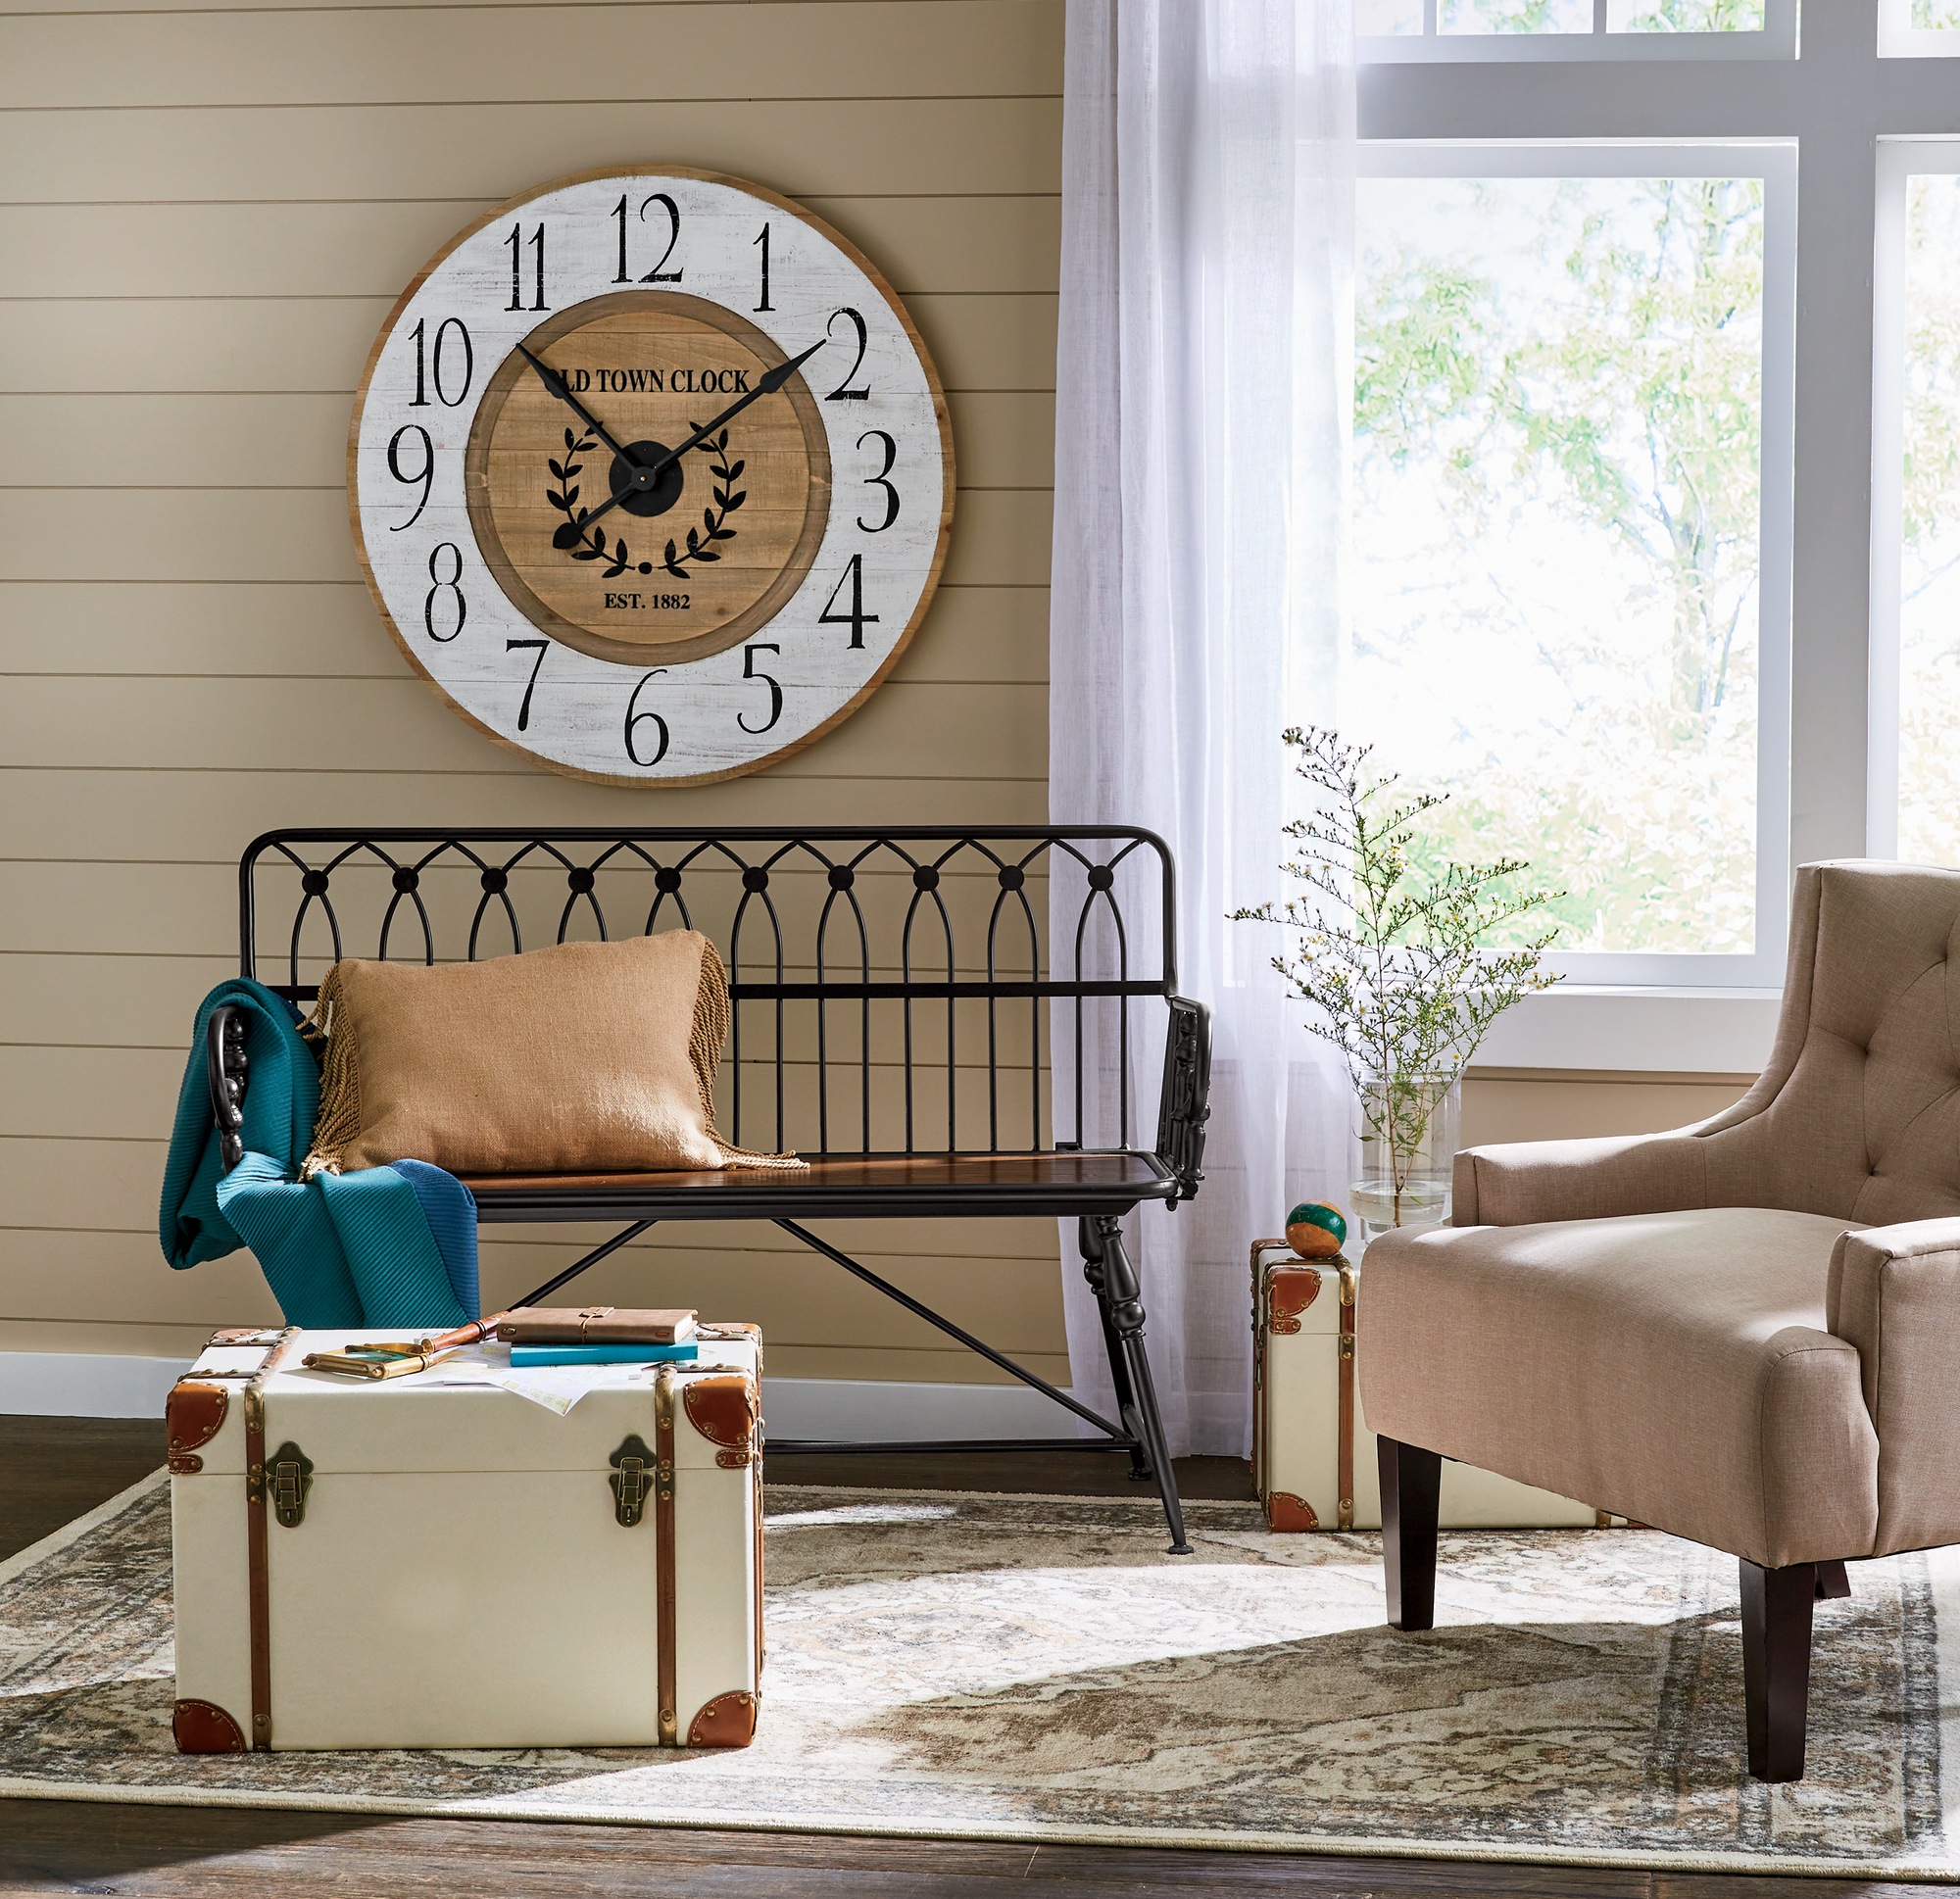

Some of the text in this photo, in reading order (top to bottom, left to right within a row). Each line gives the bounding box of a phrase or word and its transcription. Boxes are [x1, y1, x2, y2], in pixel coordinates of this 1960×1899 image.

[503, 221, 552, 313] 11
[610, 193, 684, 283] 12
[752, 221, 776, 314] 1
[408, 316, 473, 408] 10
[596, 368, 664, 393] TOWN
[670, 368, 751, 393] CLOCK
[823, 307, 872, 402] 2
[387, 423, 434, 532] 9
[856, 429, 901, 533] 3
[424, 542, 467, 643] 8
[604, 593, 691, 609] EST. 1882
[818, 554, 880, 651] 4
[506, 639, 551, 732] 7
[623, 668, 671, 767] 6
[737, 643, 783, 735] 5
